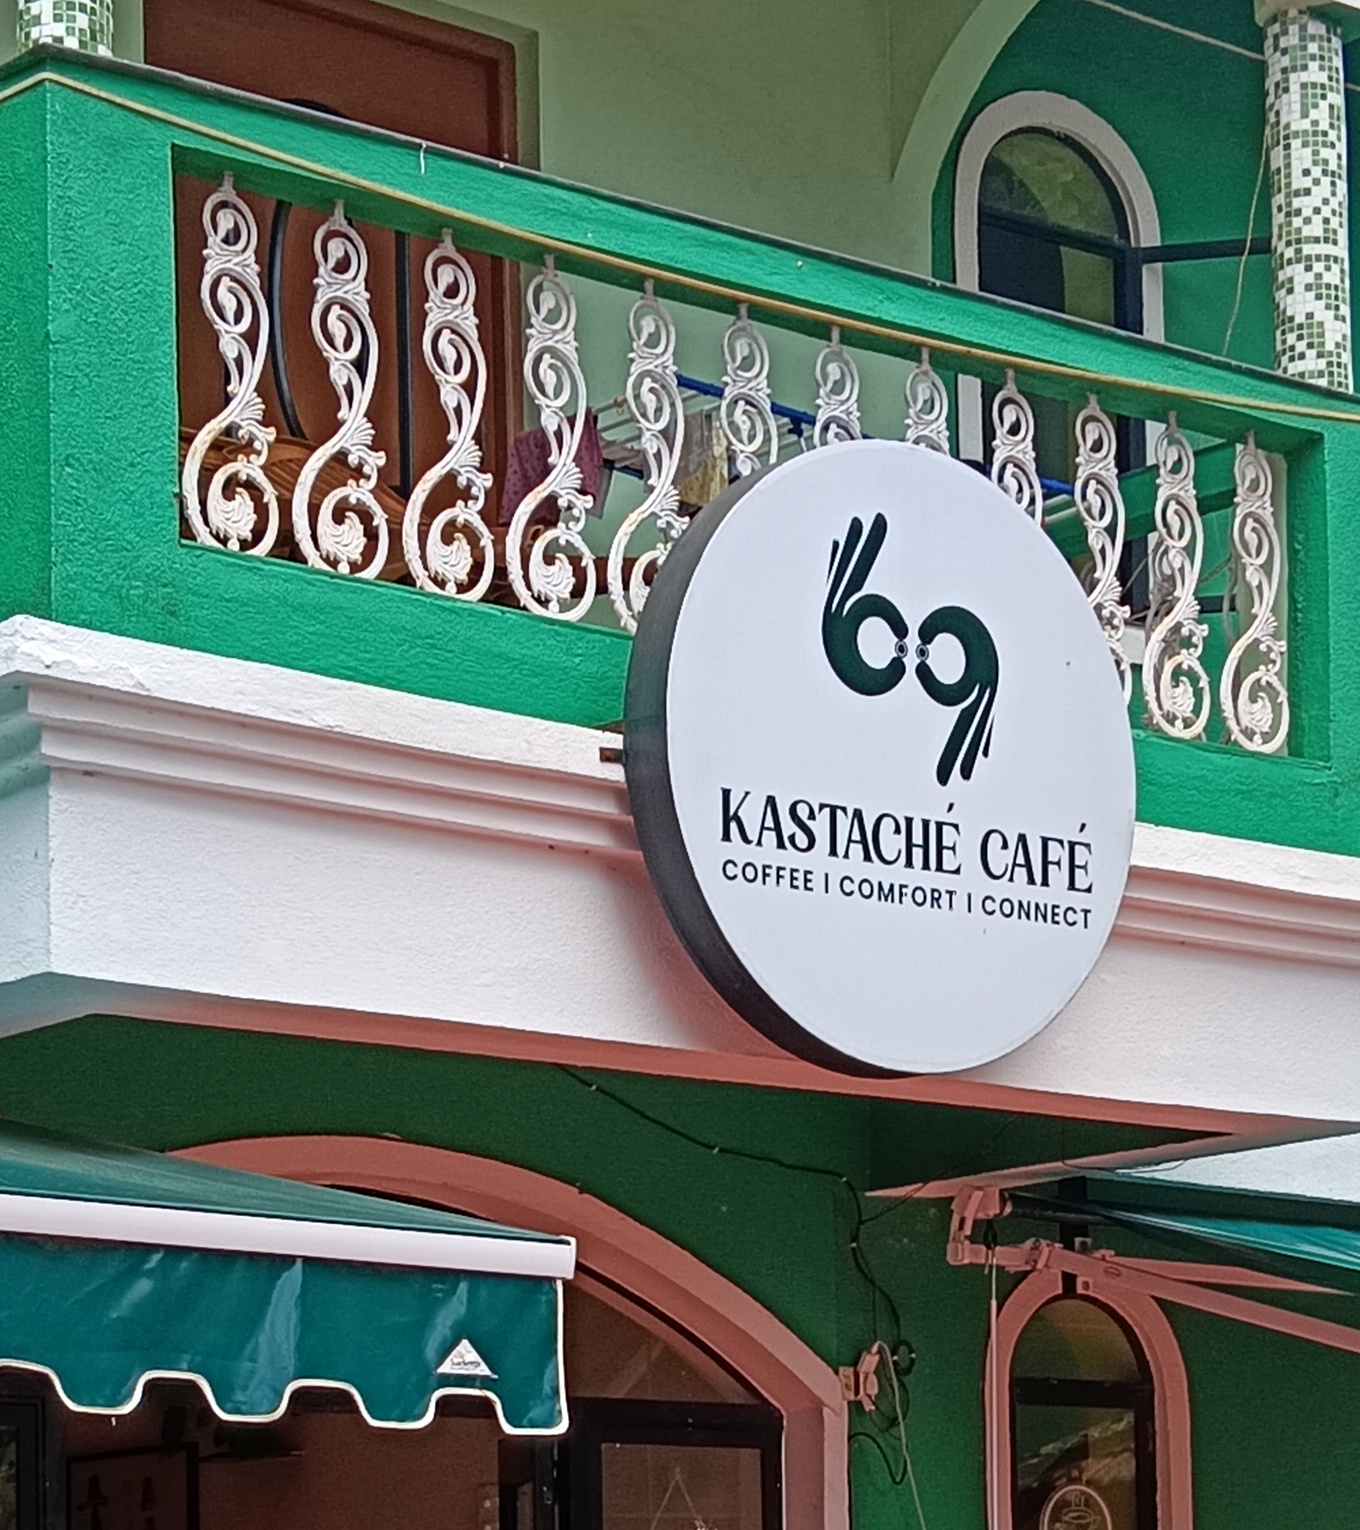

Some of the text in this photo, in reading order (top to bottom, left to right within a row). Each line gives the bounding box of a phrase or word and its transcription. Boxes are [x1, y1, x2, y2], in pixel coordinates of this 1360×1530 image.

[720, 786, 1093, 894] KASTACHÉ CAFÉ
[722, 858, 814, 893] COFFEE
[839, 874, 956, 913] COMFORT
[981, 895, 1092, 930] CONNECT
